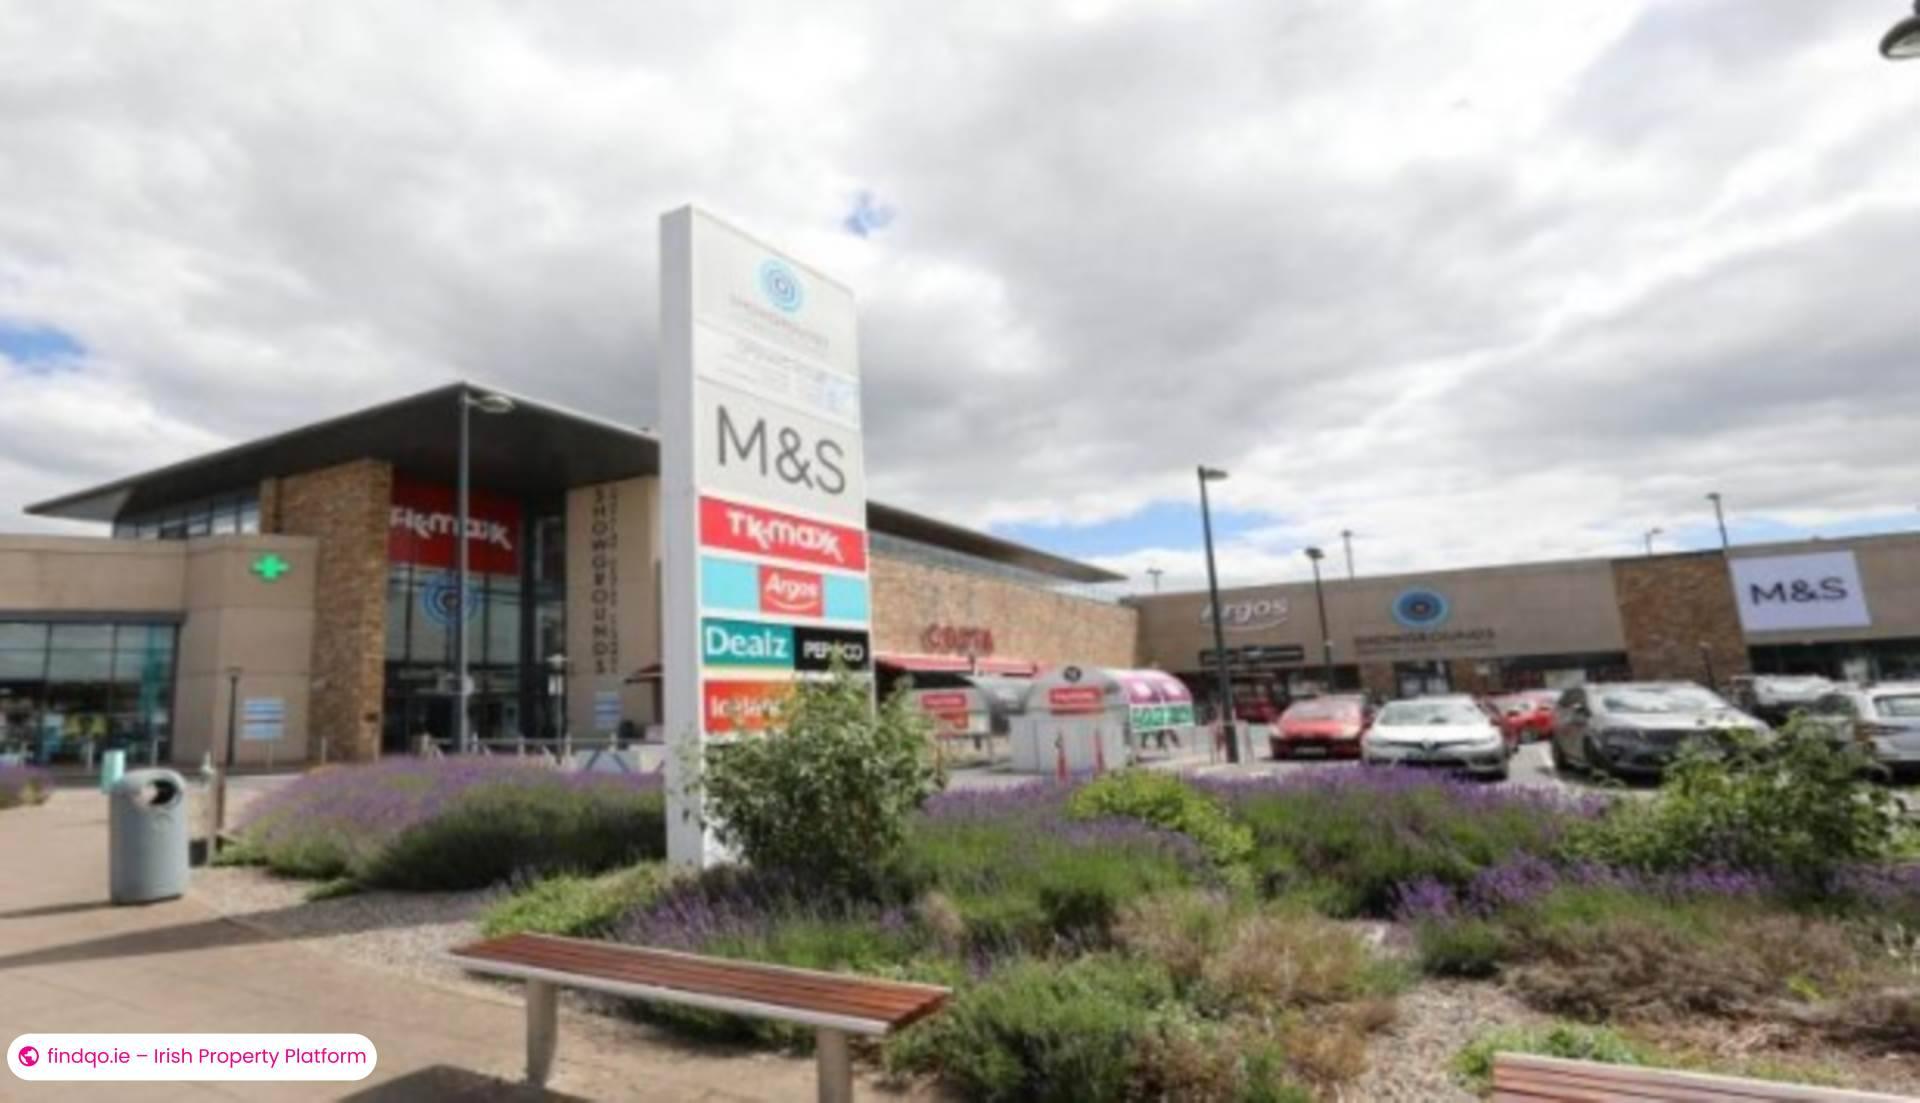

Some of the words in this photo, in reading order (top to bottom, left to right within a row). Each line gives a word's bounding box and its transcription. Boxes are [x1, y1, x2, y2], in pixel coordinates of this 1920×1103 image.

[717, 403, 846, 494] M&S
[765, 571, 819, 600] Argos
[1749, 576, 1848, 606] M&S
[705, 626, 789, 658] Dealz
[803, 640, 864, 661] PEPCO
